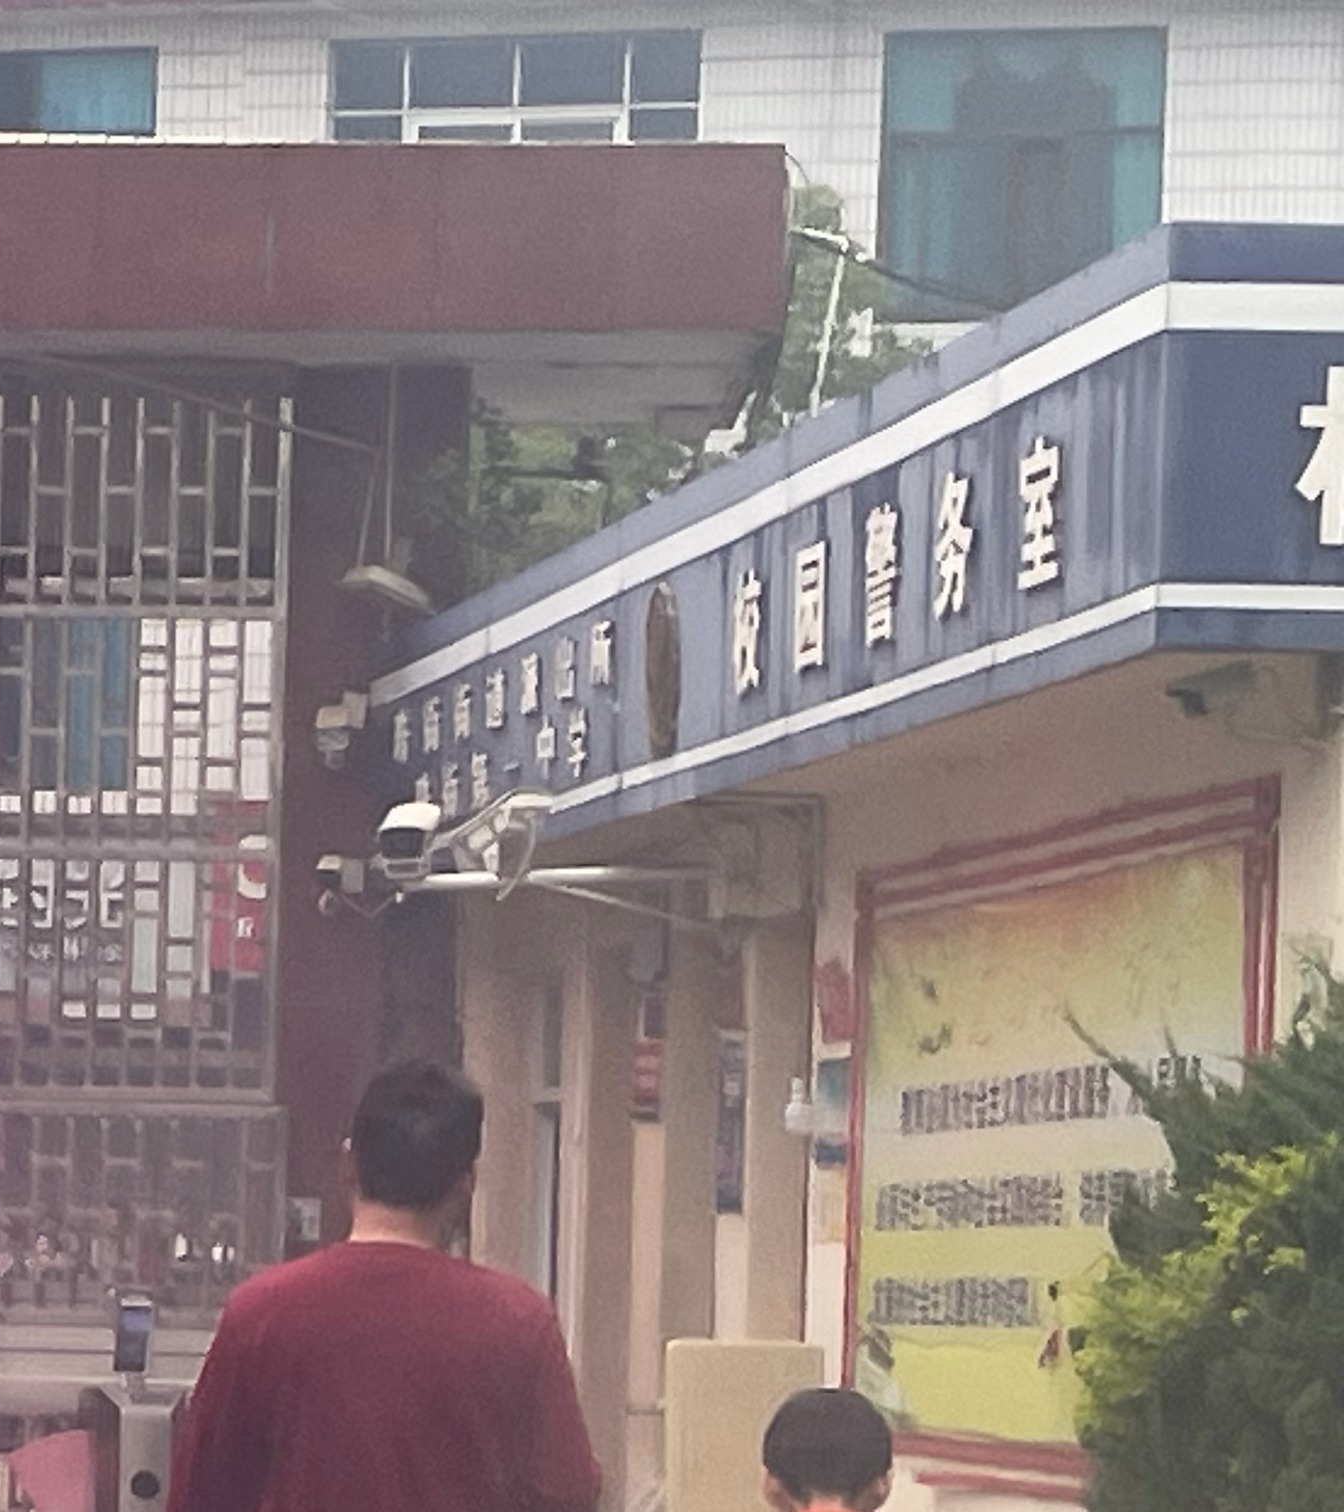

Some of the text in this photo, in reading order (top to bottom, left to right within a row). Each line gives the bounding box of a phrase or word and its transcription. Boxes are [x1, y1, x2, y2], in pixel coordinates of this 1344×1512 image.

[735, 435, 1060, 698] 校园警务室
